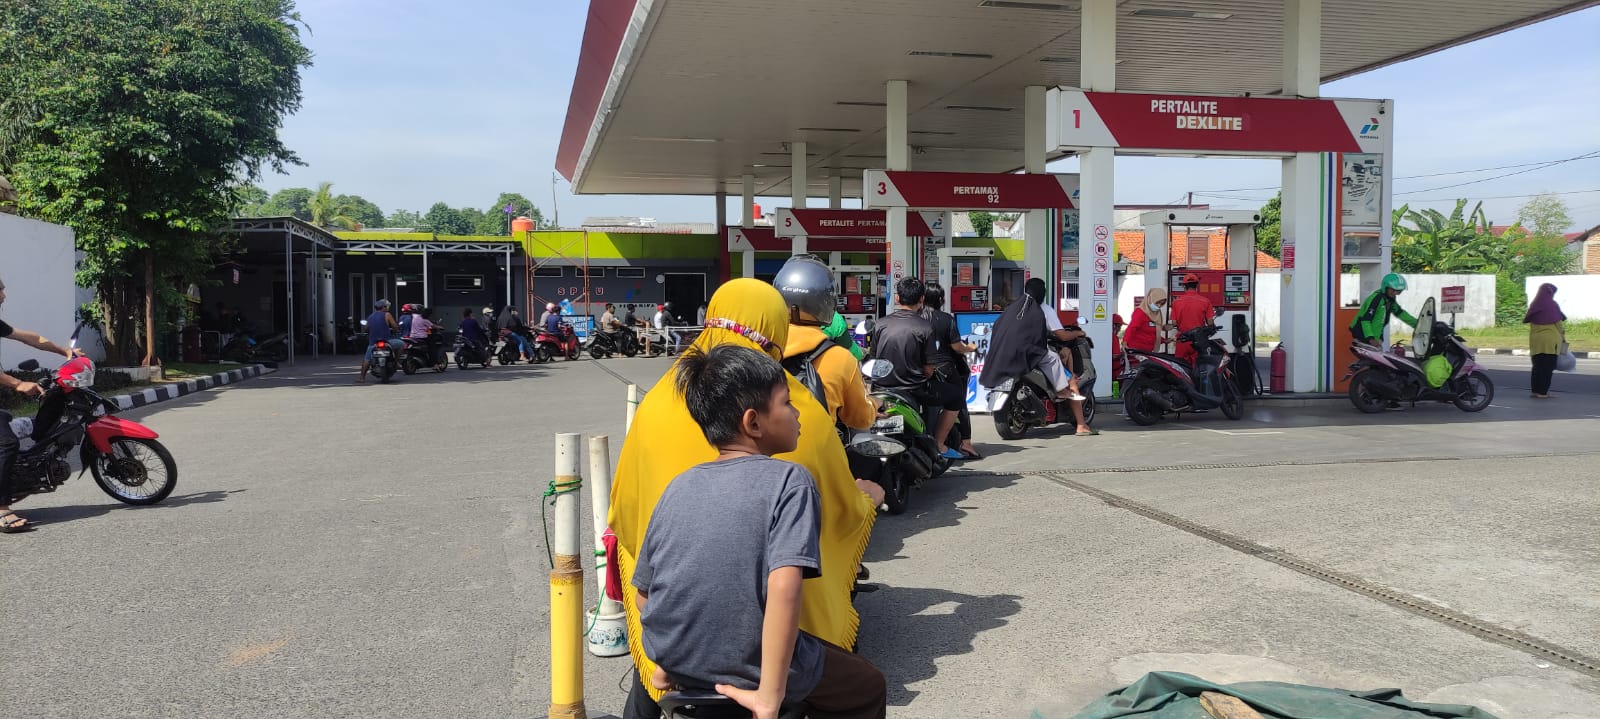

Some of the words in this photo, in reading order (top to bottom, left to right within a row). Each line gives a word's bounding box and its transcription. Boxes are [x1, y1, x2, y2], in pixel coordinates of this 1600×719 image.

[1151, 99, 1218, 115] PERTALITE
[1072, 109, 1081, 129] 1
[1176, 115, 1243, 131] DEXLITE
[877, 182, 887, 195] 3
[953, 186, 999, 195] PERTAMAX
[987, 194, 1000, 203] 92
[785, 217, 792, 227] 5
[819, 219, 855, 227] PERTALITE
[735, 235, 741, 243] 7
